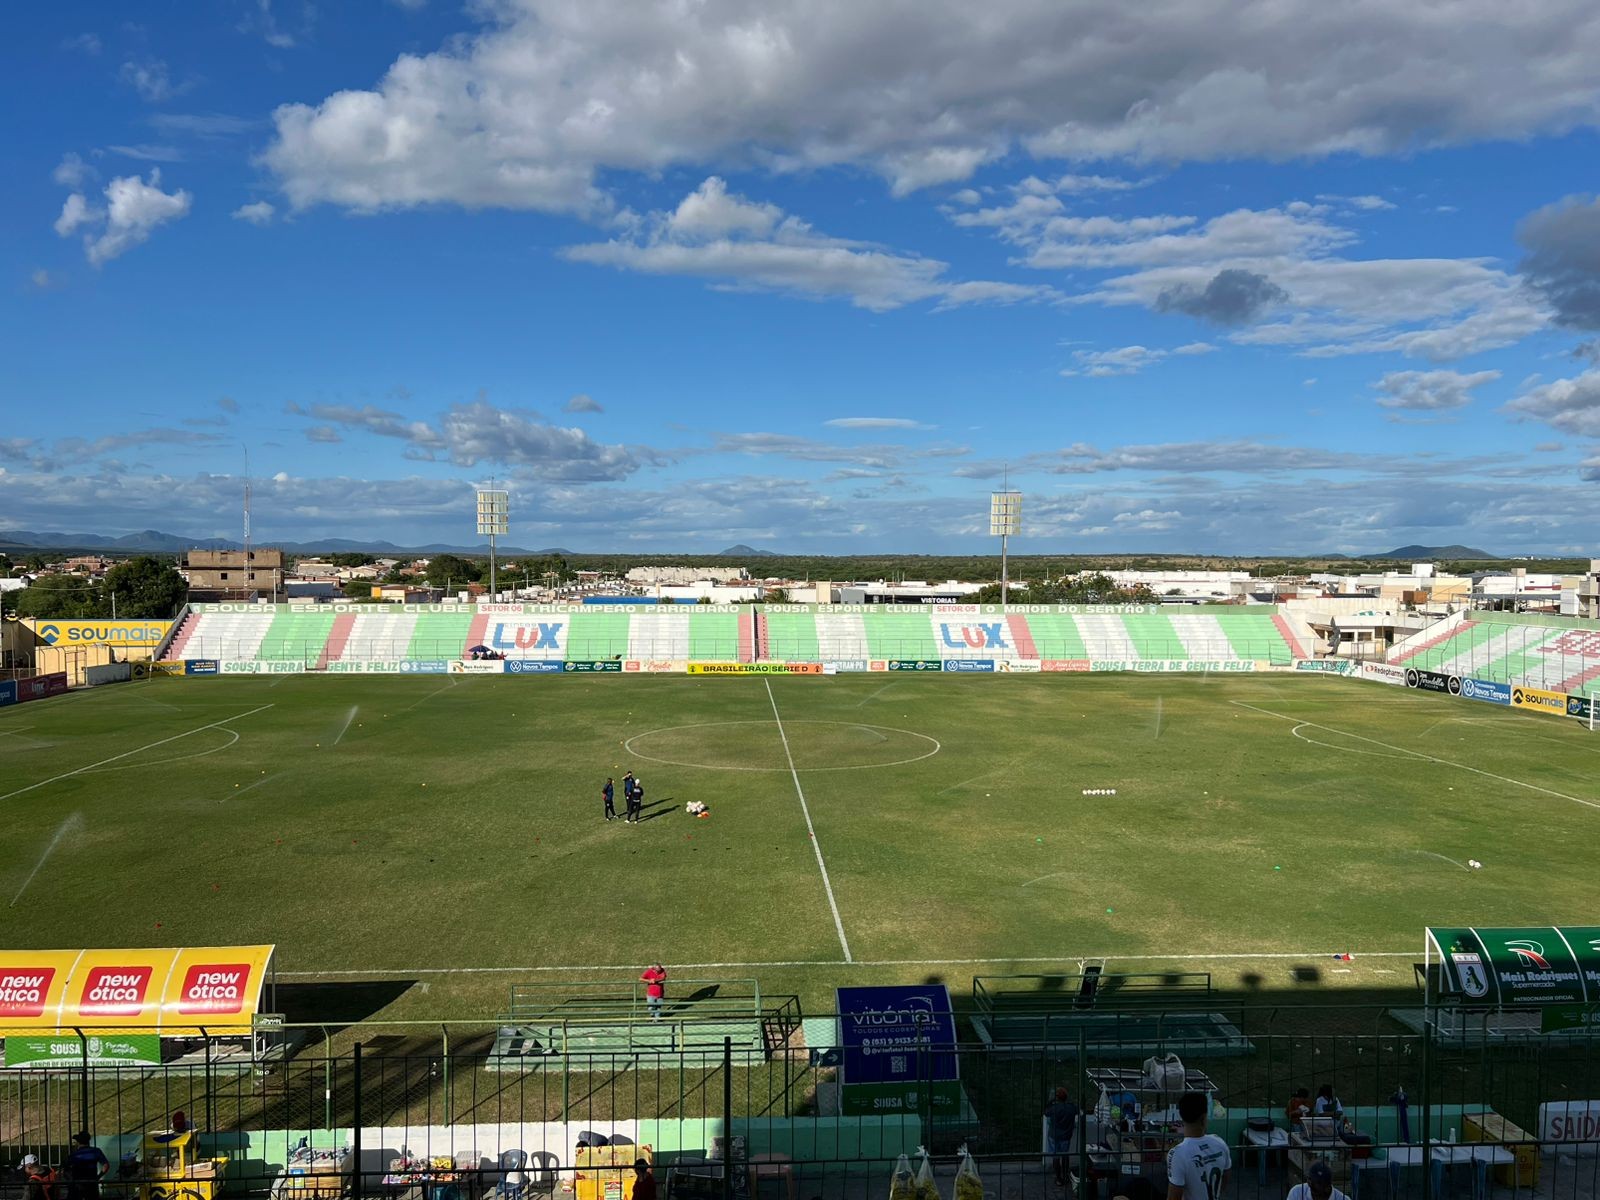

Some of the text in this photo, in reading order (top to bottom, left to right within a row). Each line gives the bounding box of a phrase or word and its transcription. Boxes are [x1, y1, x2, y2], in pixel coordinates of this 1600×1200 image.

[204, 604, 470, 613] SOUSA ESPORTE CLUBE
[481, 604, 523, 612] SETOR 06
[527, 603, 740, 613] TRICAMPEÃO PARAIBANO
[764, 604, 928, 613] SOUSA ESPORTE CLUBE
[985, 605, 996, 613] O
[1004, 605, 1050, 613] MAIOR
[1085, 604, 1145, 613] SERTÃO
[67, 622, 163, 642] soumais
[224, 661, 262, 673] SOUSA
[267, 661, 302, 672] TERRA
[328, 661, 363, 672] GENTE
[367, 661, 399, 672] FELIZ
[703, 664, 769, 672] BRASILEIRÃO
[771, 664, 799, 673] SÉRIE
[1091, 661, 1127, 672] SOUSA
[1131, 661, 1167, 672] TERRA
[1169, 661, 1183, 671] DE
[1186, 661, 1221, 671] GENTE
[1223, 661, 1254, 671] FELIZ
[1374, 665, 1405, 678] Redepharma
[1475, 686, 1510, 701] Novos Tempos
[1525, 693, 1564, 708] soumais
[1, 975, 45, 988] new
[98, 974, 142, 987] new
[197, 972, 241, 985] new
[1500, 970, 1579, 983] Mais Rodrigues
[89, 986, 138, 1002] ótica
[188, 984, 238, 999] ótica
[50, 1043, 81, 1055] SOUSA
